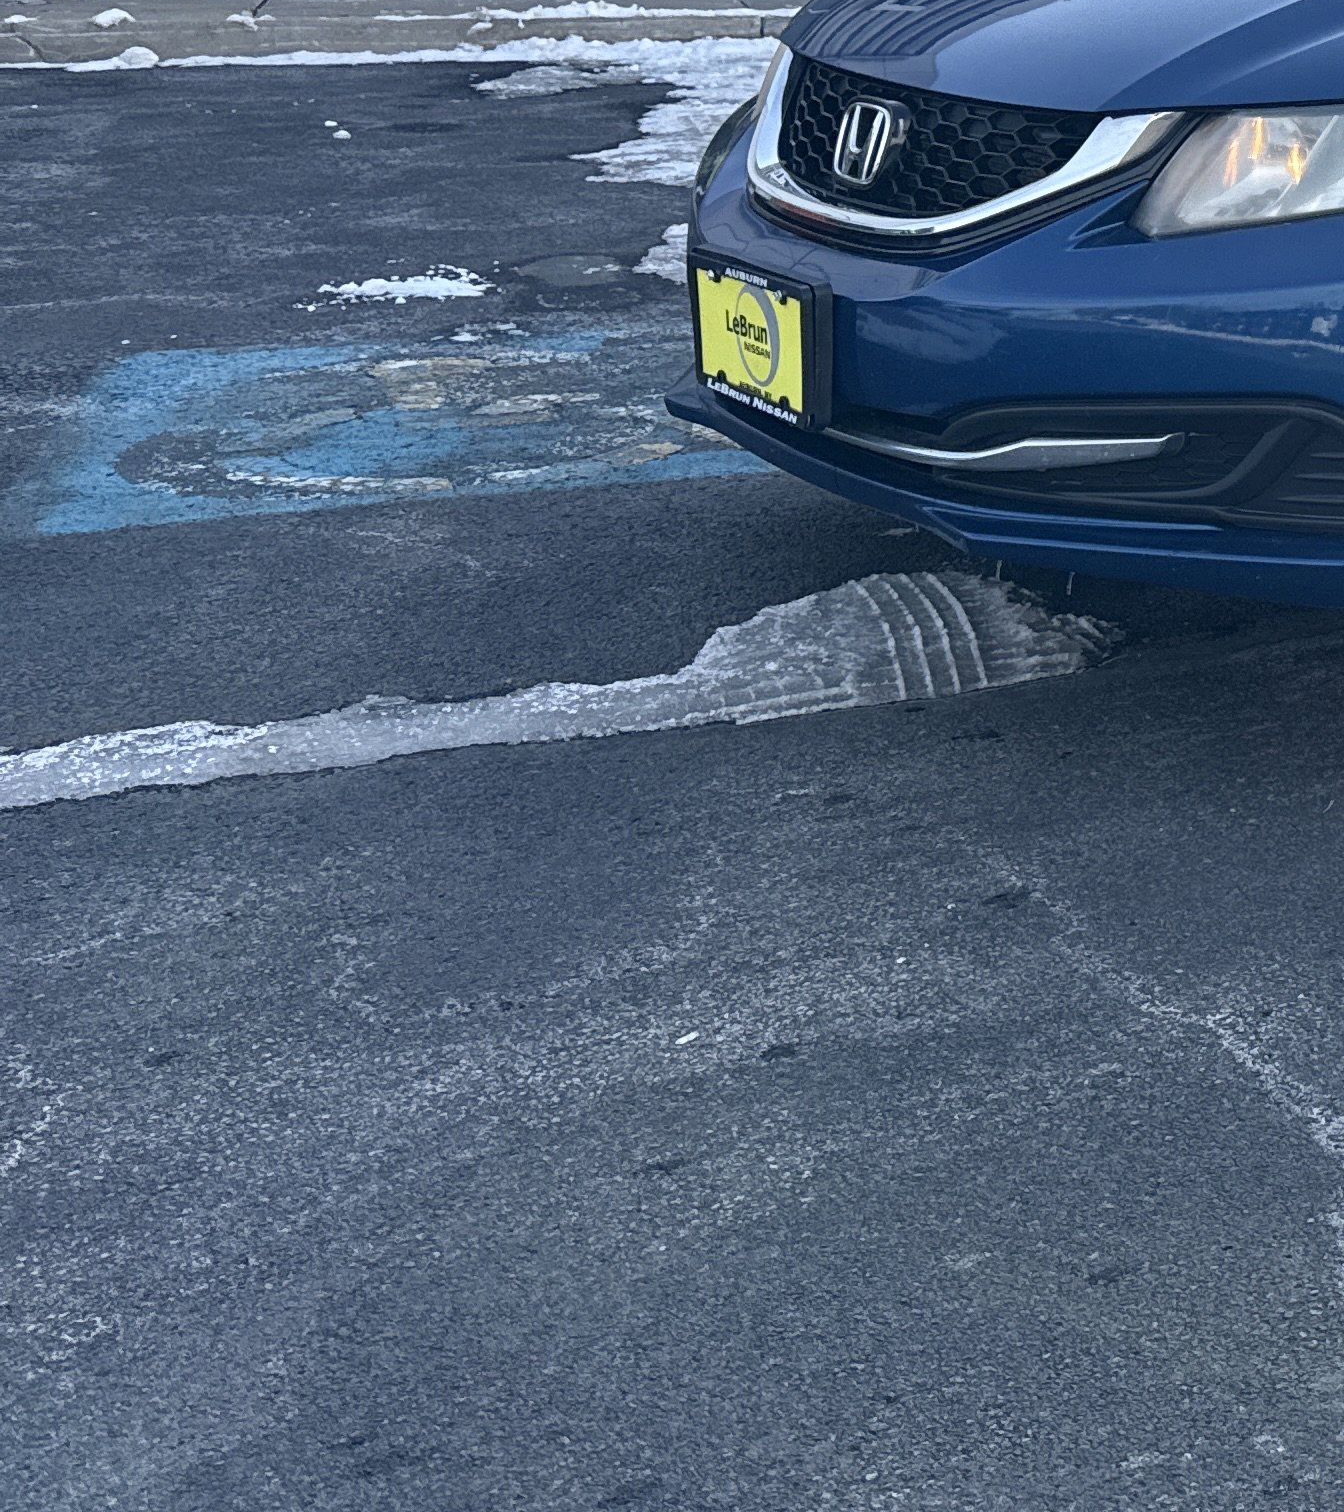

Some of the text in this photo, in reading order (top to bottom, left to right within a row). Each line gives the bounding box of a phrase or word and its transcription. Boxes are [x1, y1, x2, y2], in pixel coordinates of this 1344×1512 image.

[724, 267, 768, 288] AUBURN
[725, 309, 768, 345] LeBrun
[743, 341, 771, 360] NISSAN
[752, 396, 798, 424] NISSAN
